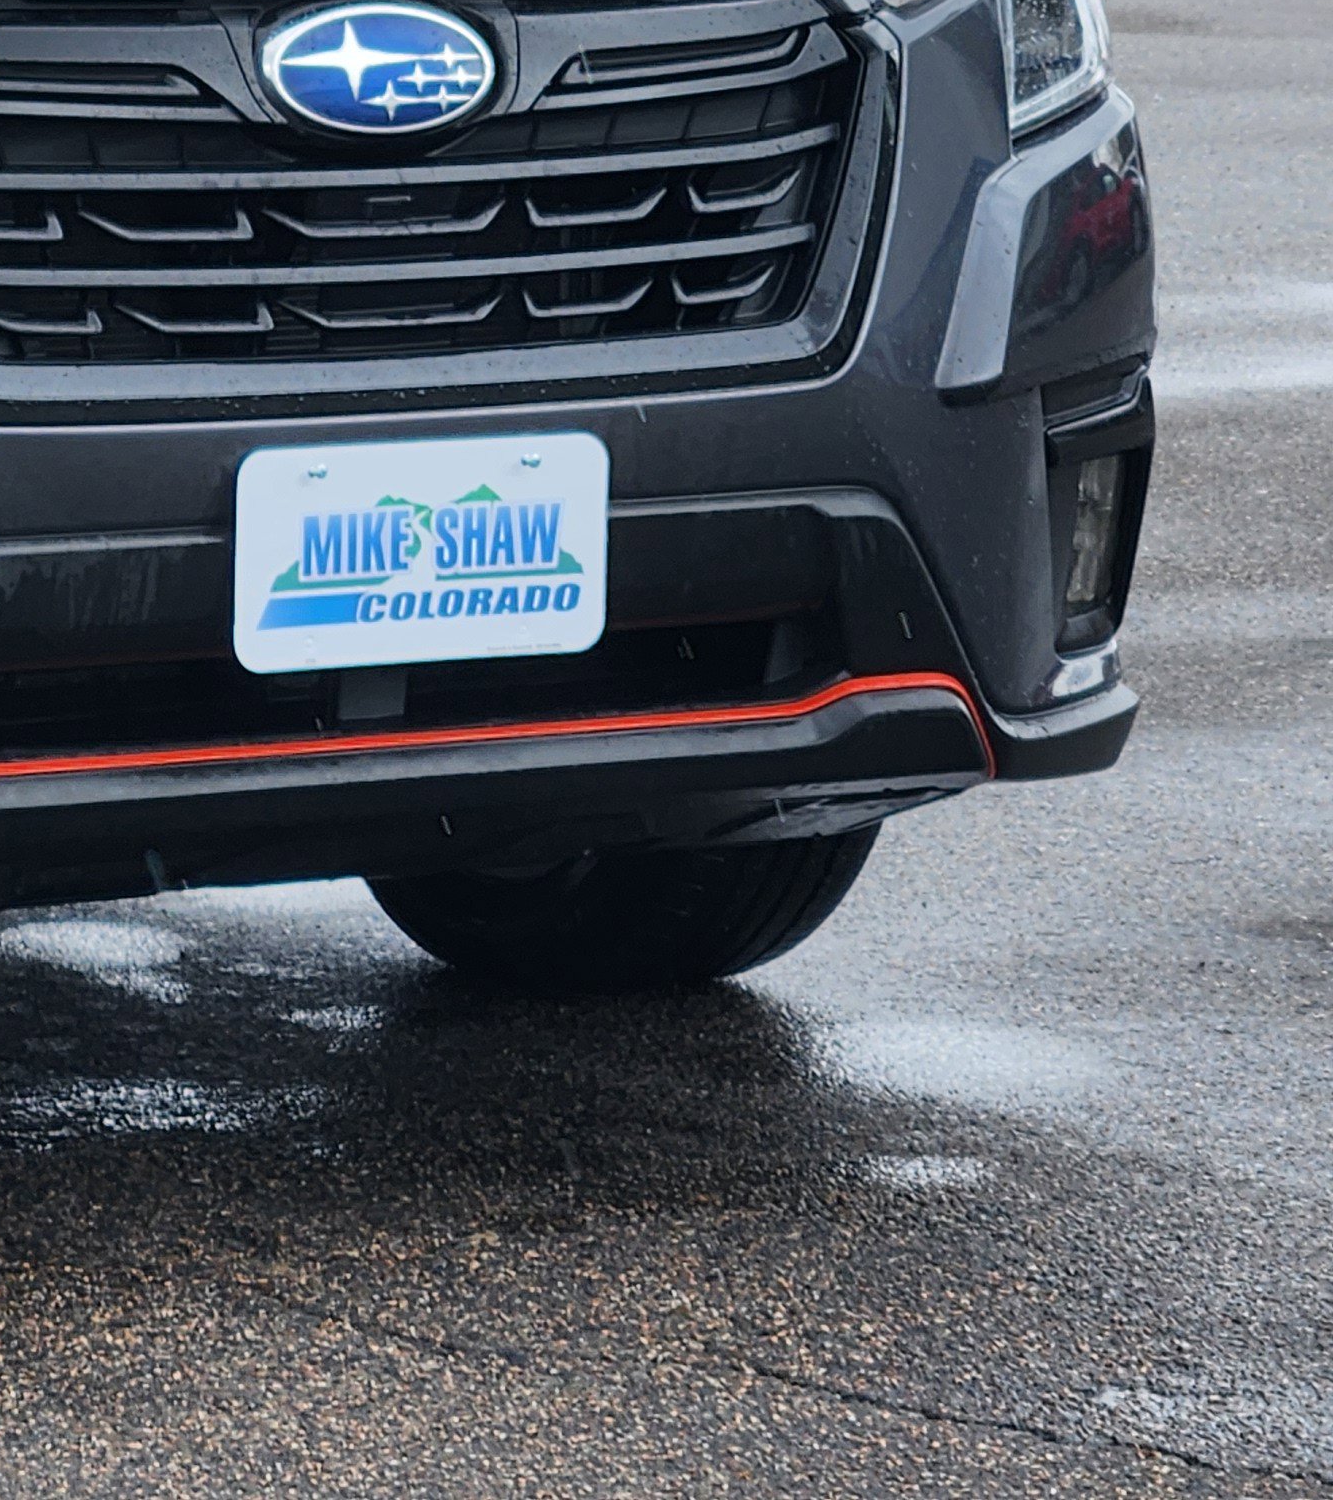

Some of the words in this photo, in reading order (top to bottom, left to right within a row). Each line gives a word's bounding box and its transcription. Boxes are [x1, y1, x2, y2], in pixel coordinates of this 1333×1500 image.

[301, 509, 411, 578] MIKE
[434, 502, 562, 570] SHAW
[358, 582, 582, 624] COLORADO
